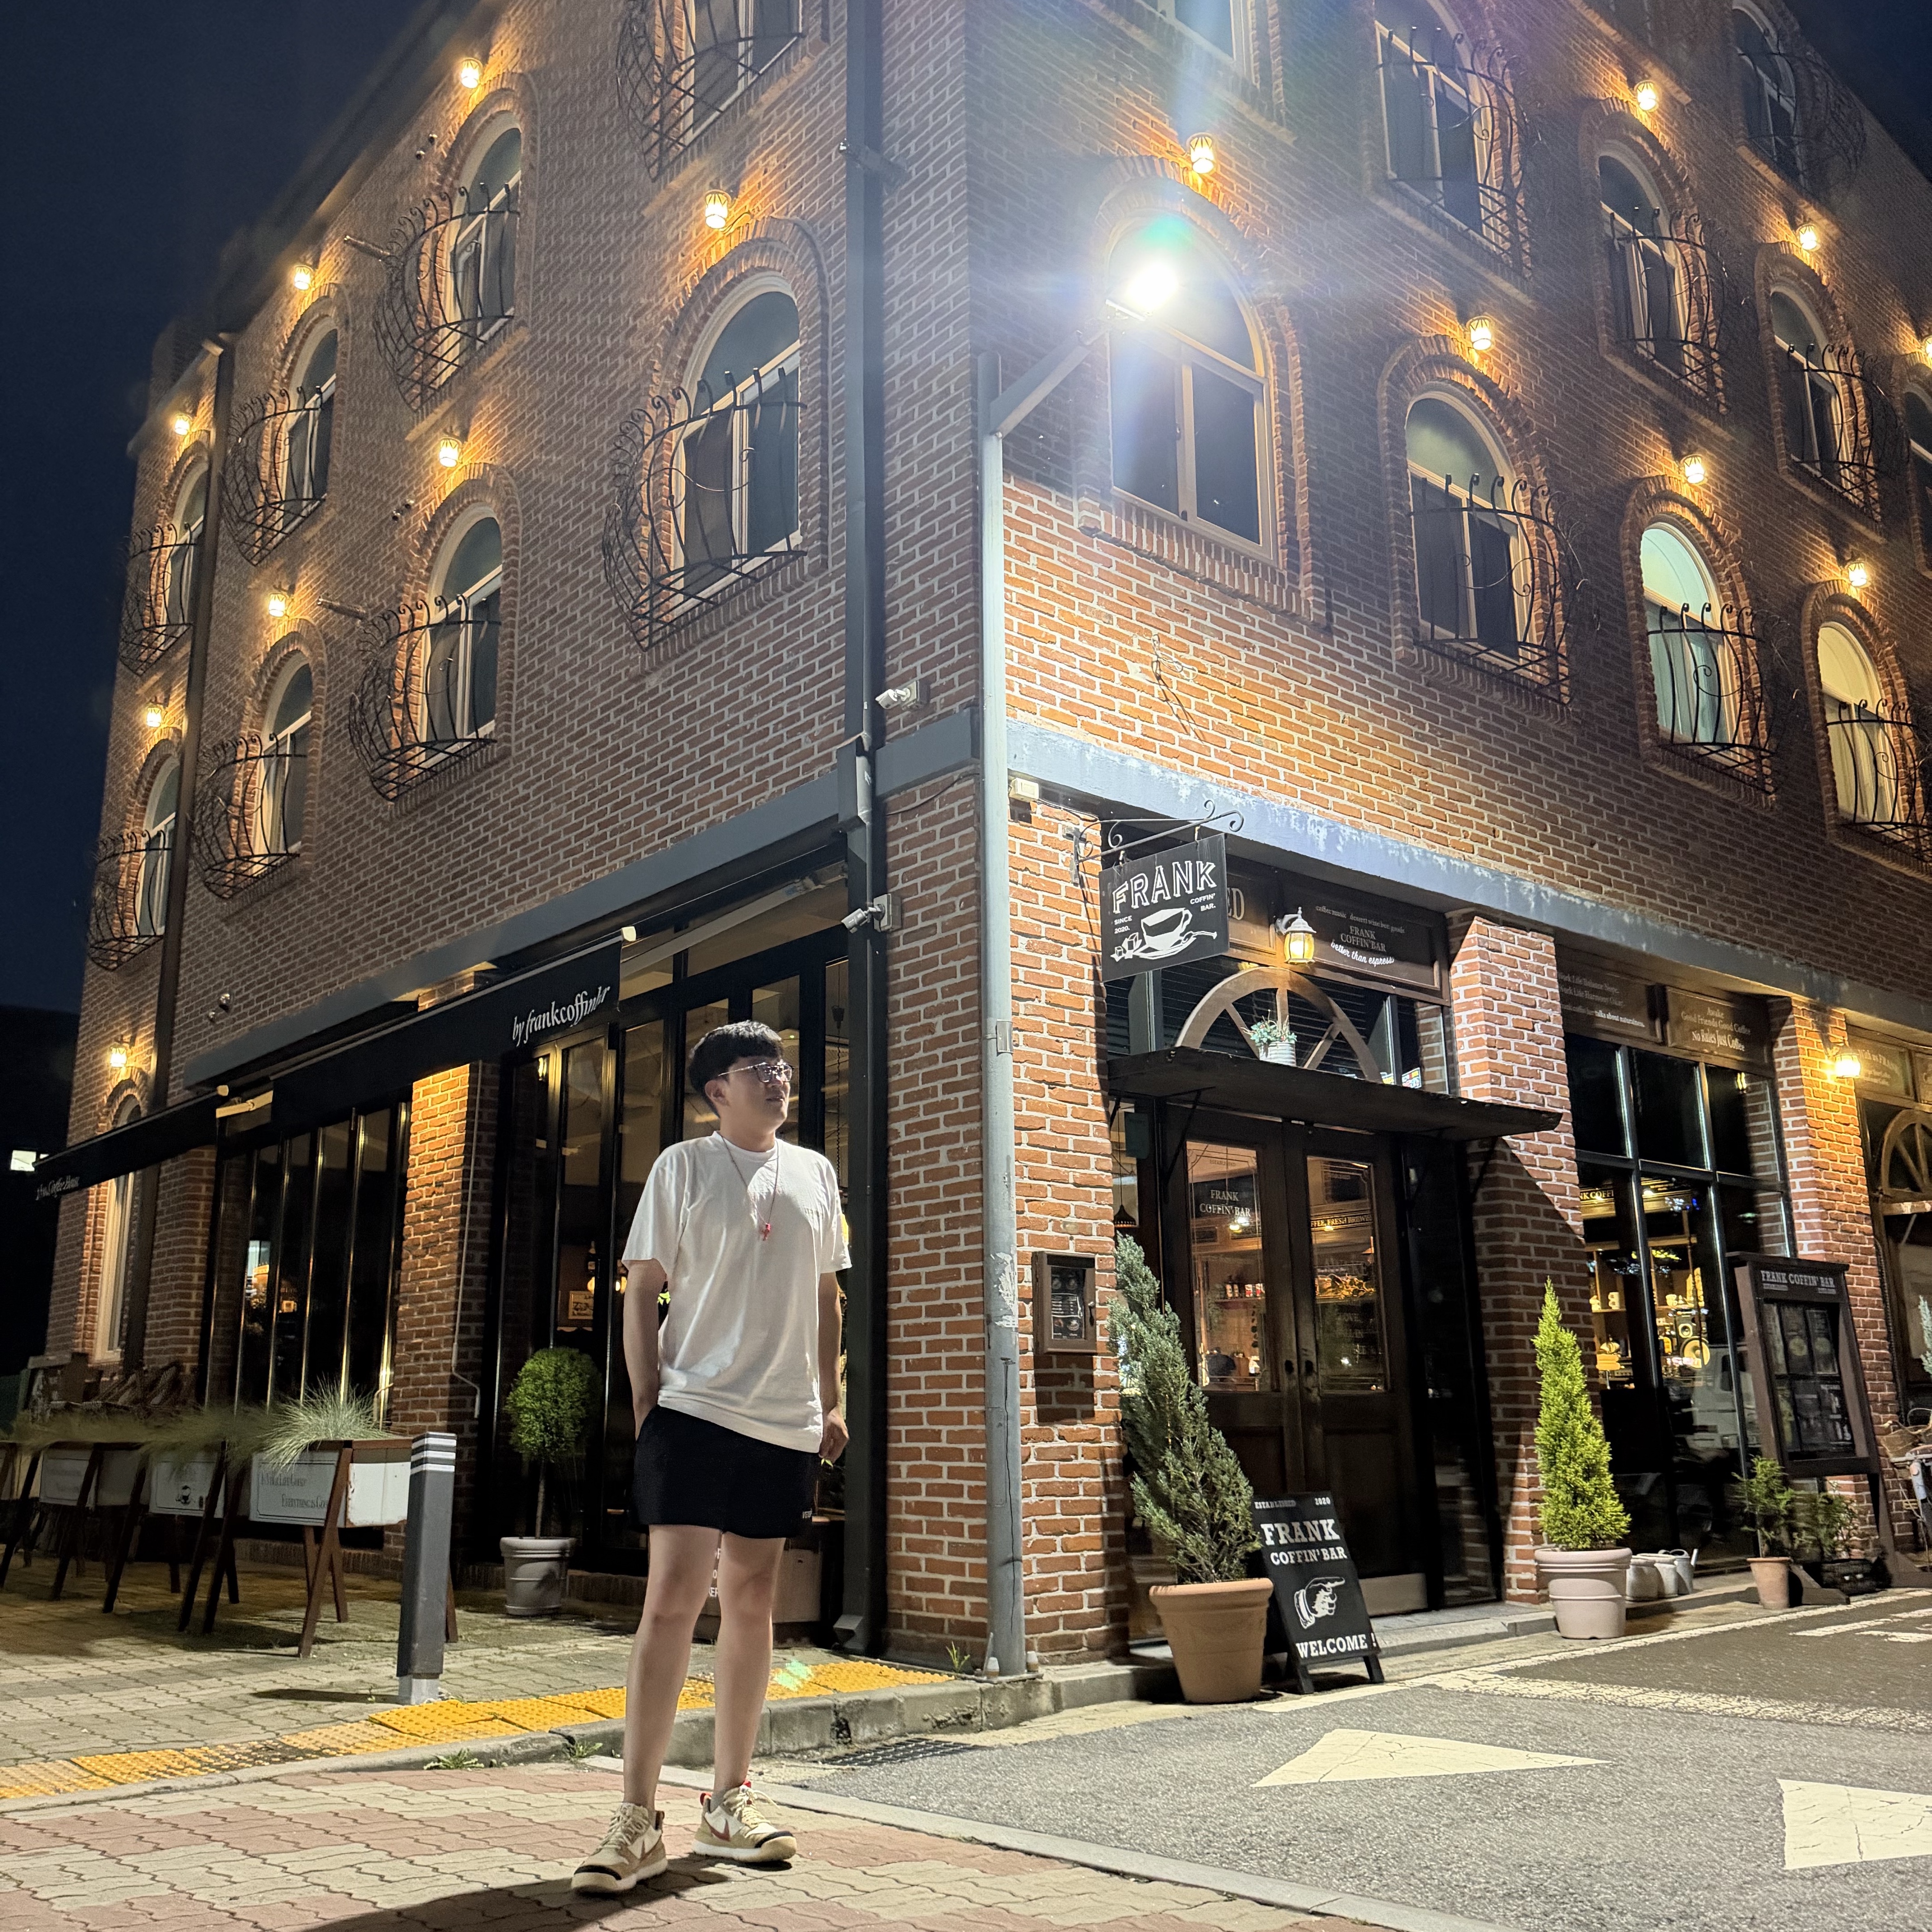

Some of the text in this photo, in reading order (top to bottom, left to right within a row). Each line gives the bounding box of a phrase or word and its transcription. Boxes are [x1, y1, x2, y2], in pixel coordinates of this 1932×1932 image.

[1113, 860, 1217, 914] FRANK
[1201, 903, 1216, 911] BAR.
[1114, 915, 1132, 925] SINCE
[1114, 926, 1130, 934] 2020.
[1350, 926, 1375, 940] FRANK
[1331, 939, 1350, 957] better
[1352, 951, 1367, 963] than
[512, 1016, 525, 1047] by
[1692, 1031, 1701, 1041] No
[1211, 1190, 1239, 1201] FRANK
[1761, 1270, 1788, 1283] FRANK
[1819, 1277, 1835, 1288] BAR
[1315, 1497, 1330, 1505] 2020
[1260, 1519, 1340, 1546] FRANK
[1322, 1546, 1348, 1560] BAR
[1296, 1634, 1367, 1659] WELCOME
